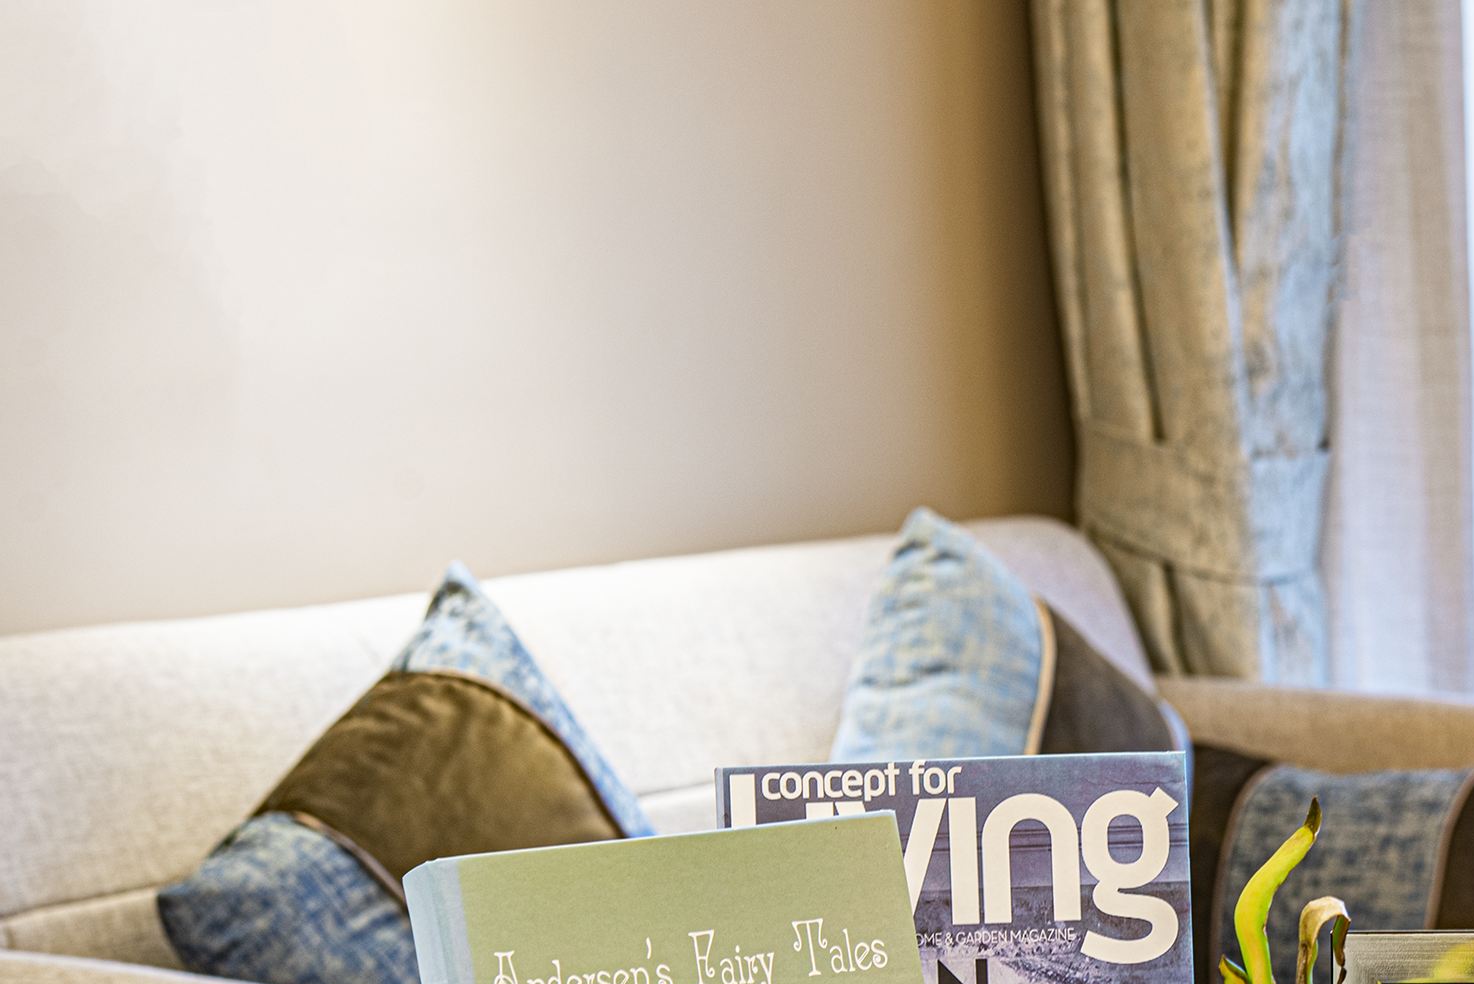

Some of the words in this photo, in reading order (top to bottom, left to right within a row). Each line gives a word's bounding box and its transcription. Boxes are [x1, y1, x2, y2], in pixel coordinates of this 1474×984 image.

[761, 762, 900, 801] concept
[909, 759, 962, 795] for
[791, 917, 888, 977] Tales
[944, 932, 954, 945] &
[956, 929, 1008, 945] GARDEN
